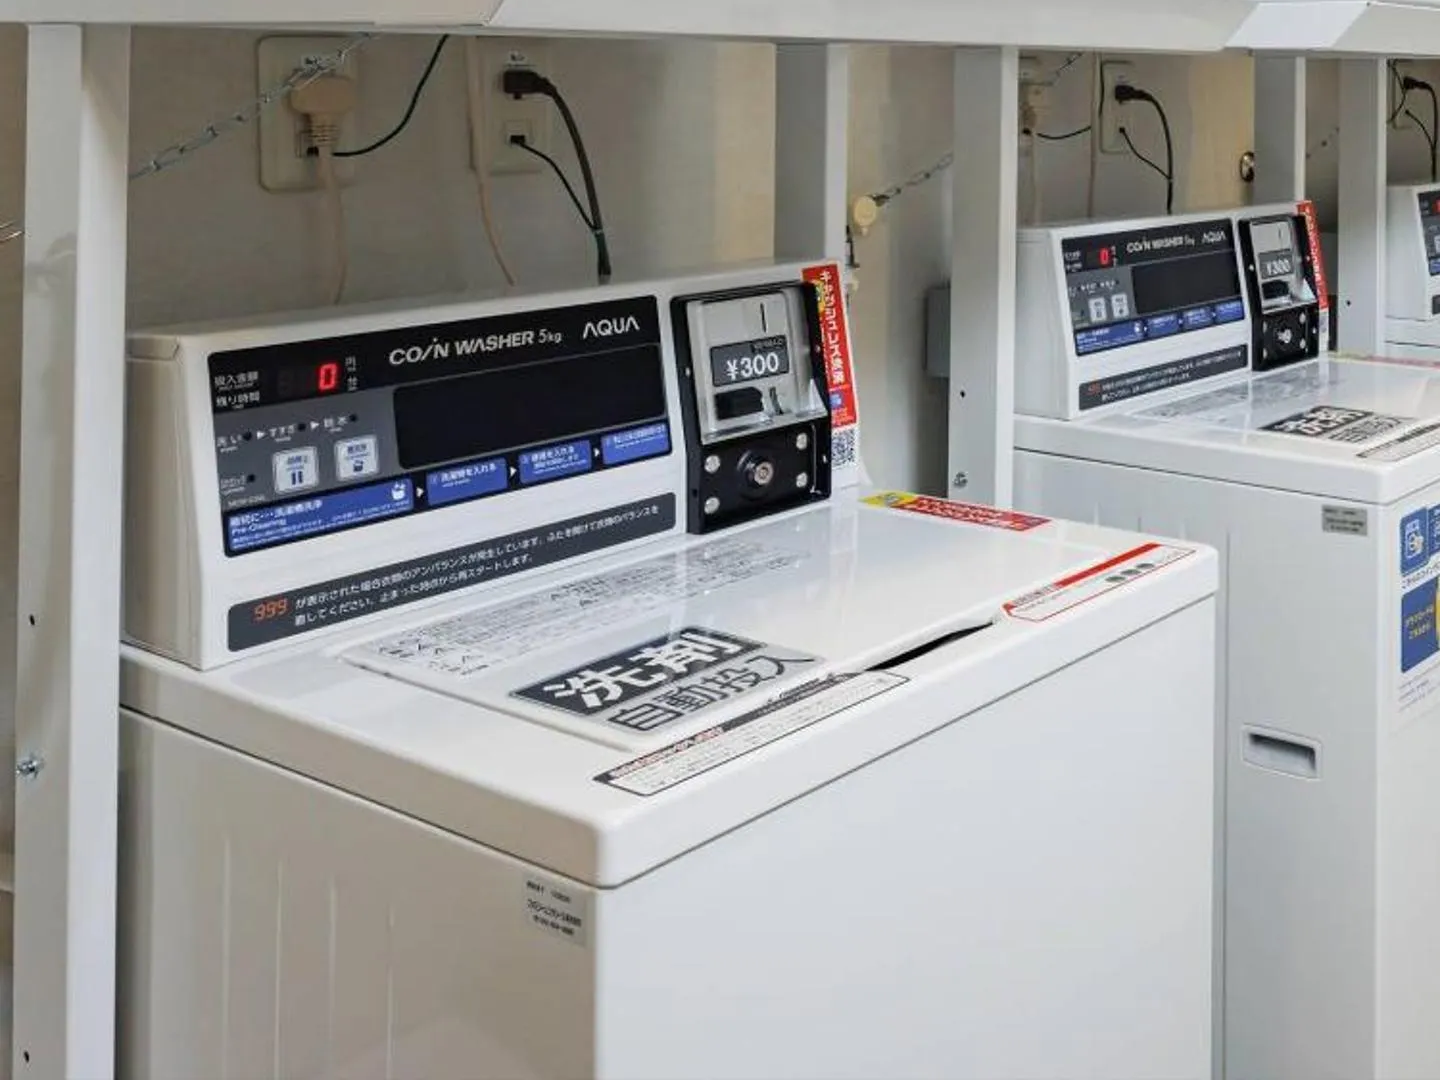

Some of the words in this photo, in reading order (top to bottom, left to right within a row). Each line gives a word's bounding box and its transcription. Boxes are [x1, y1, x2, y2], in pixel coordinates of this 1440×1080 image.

[1202, 230, 1226, 244] AQUA
[455, 330, 535, 356] WASHER
[538, 328, 563, 344] 5kg
[583, 315, 641, 340] AQUA
[318, 362, 338, 391] 0
[726, 352, 780, 381] ¥300
[215, 391, 261, 408] 残り時間
[253, 596, 288, 621] 999
[543, 631, 747, 709] 洗剤
[605, 654, 816, 732] 自動投入
